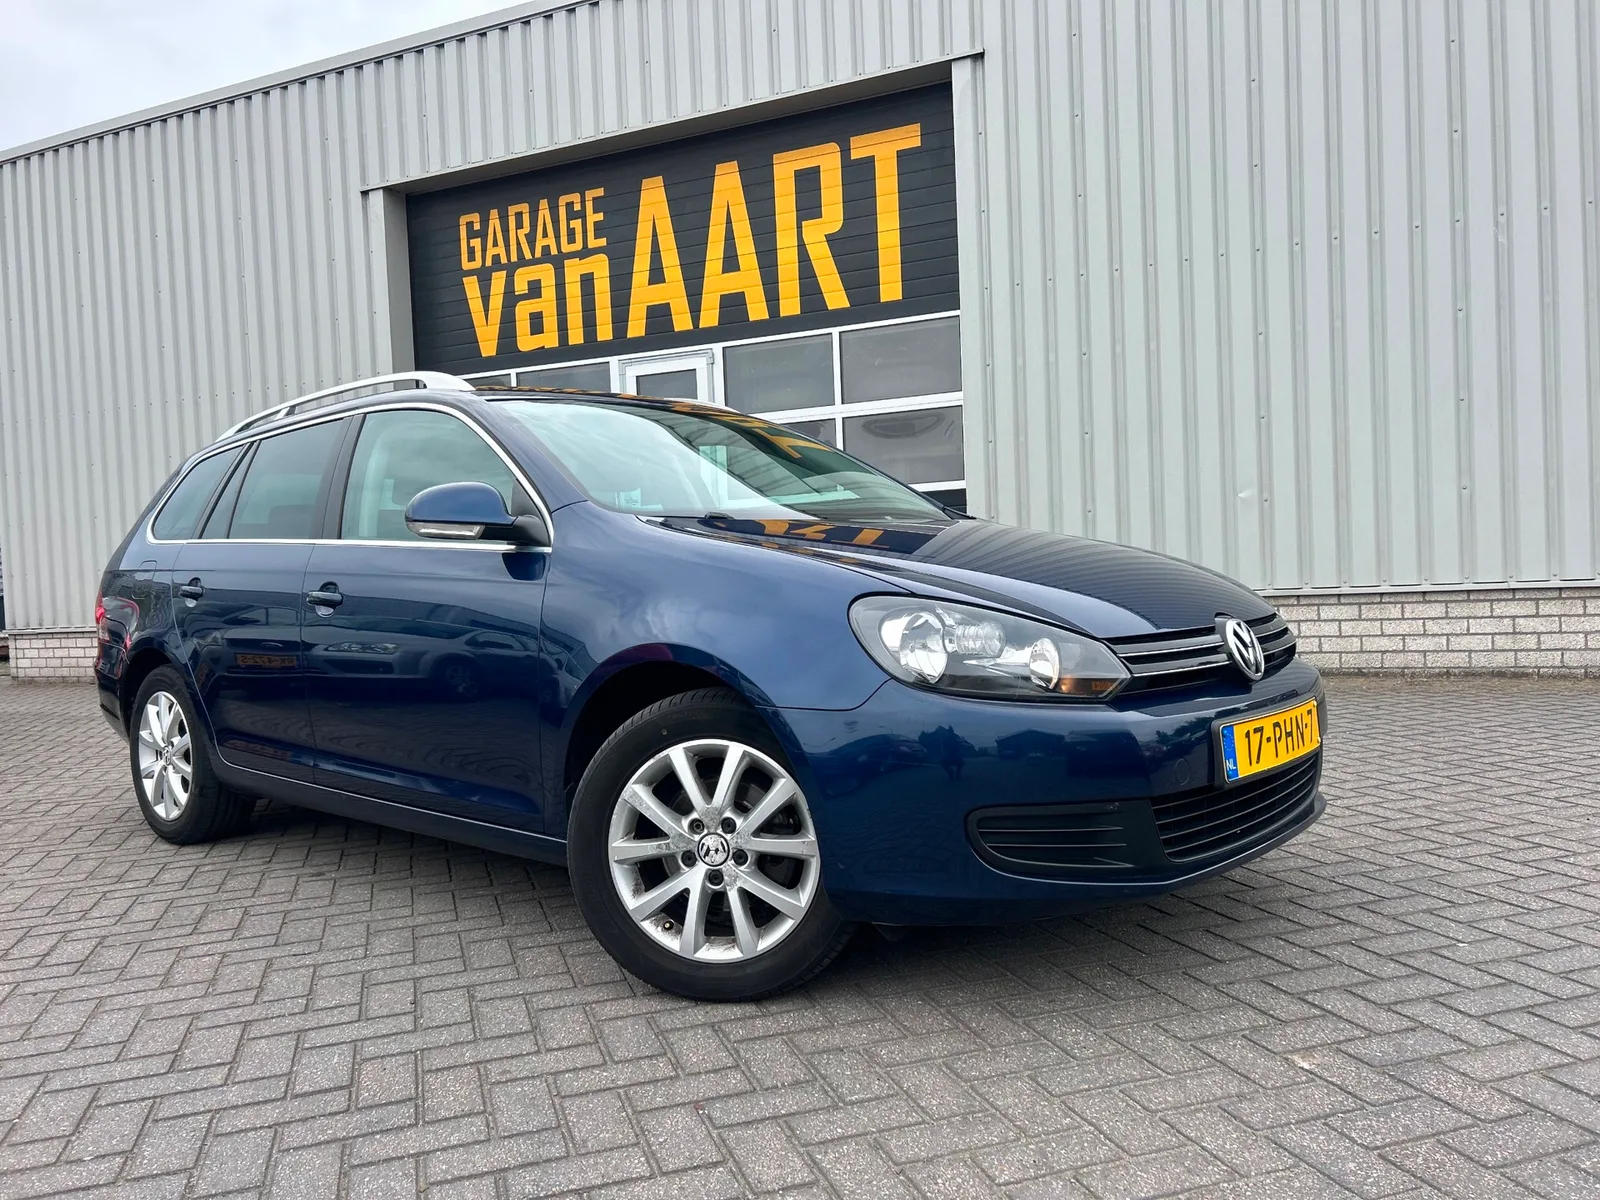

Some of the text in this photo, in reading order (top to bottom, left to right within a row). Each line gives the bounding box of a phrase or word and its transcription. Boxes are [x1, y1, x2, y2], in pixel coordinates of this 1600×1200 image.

[459, 187, 607, 271] GARAGE
[462, 122, 922, 358] van AART
[1226, 759, 1236, 770] NL
[1244, 708, 1313, 767] 17-PHN-7
